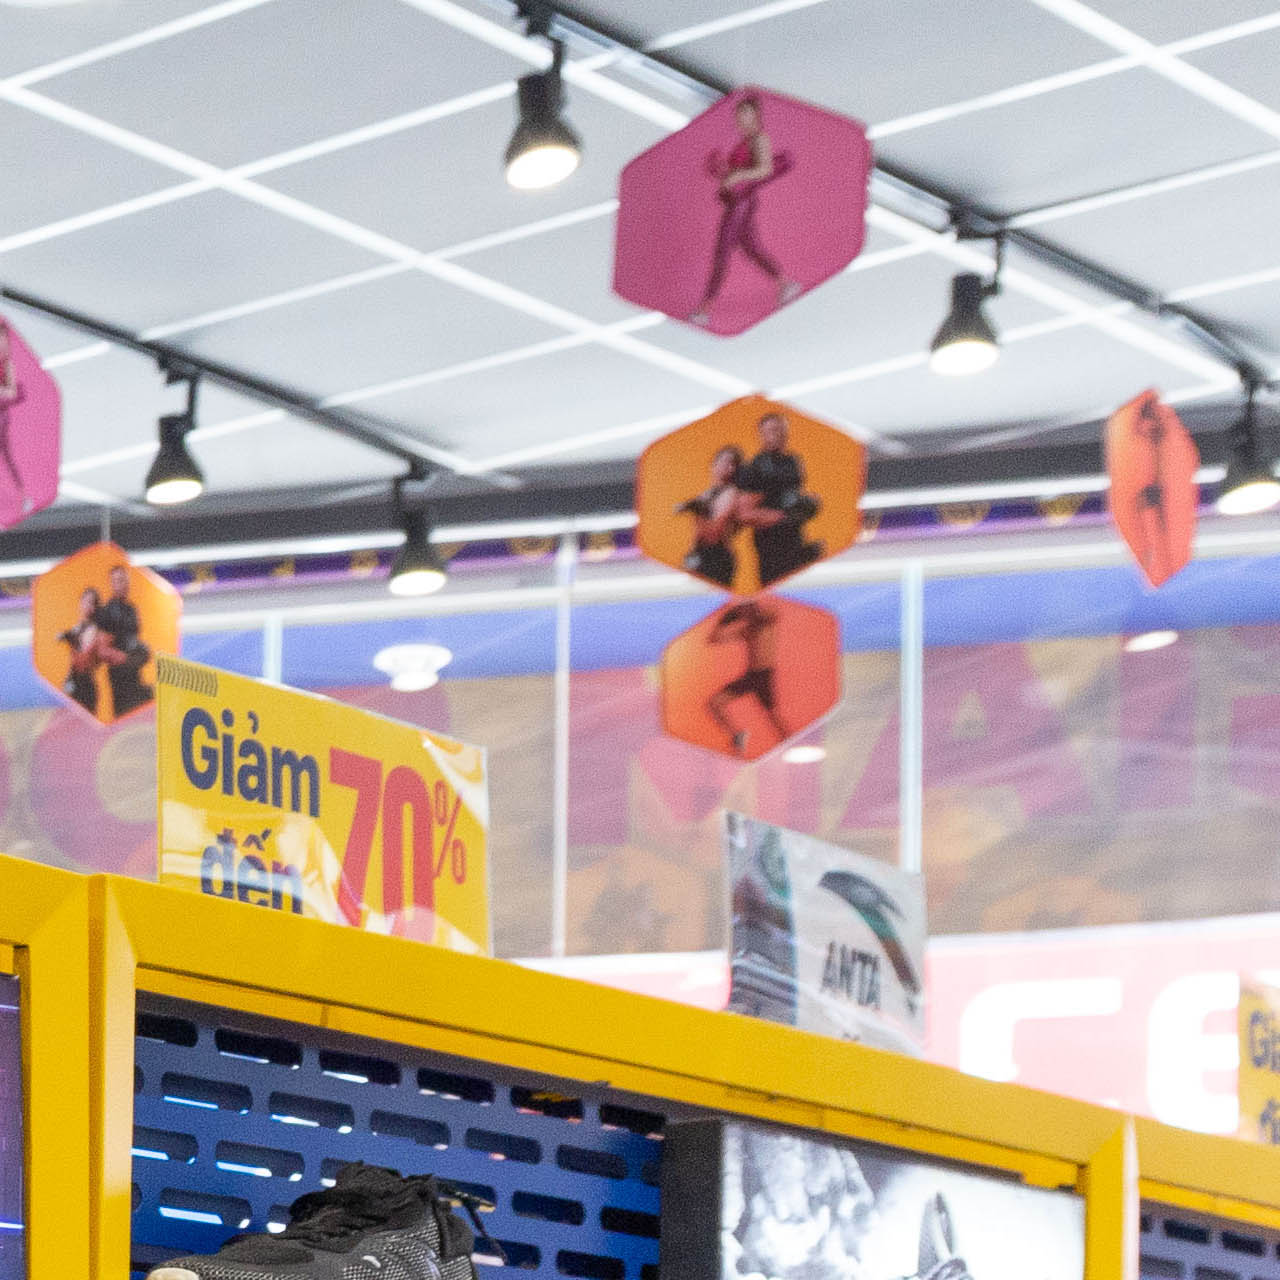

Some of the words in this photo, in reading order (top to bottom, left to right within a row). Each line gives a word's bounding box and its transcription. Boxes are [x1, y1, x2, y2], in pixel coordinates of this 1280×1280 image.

[180, 706, 321, 818] Giảm
[200, 828, 304, 914] đến
[328, 745, 467, 944] 70%
[820, 940, 882, 1011] ANTA
